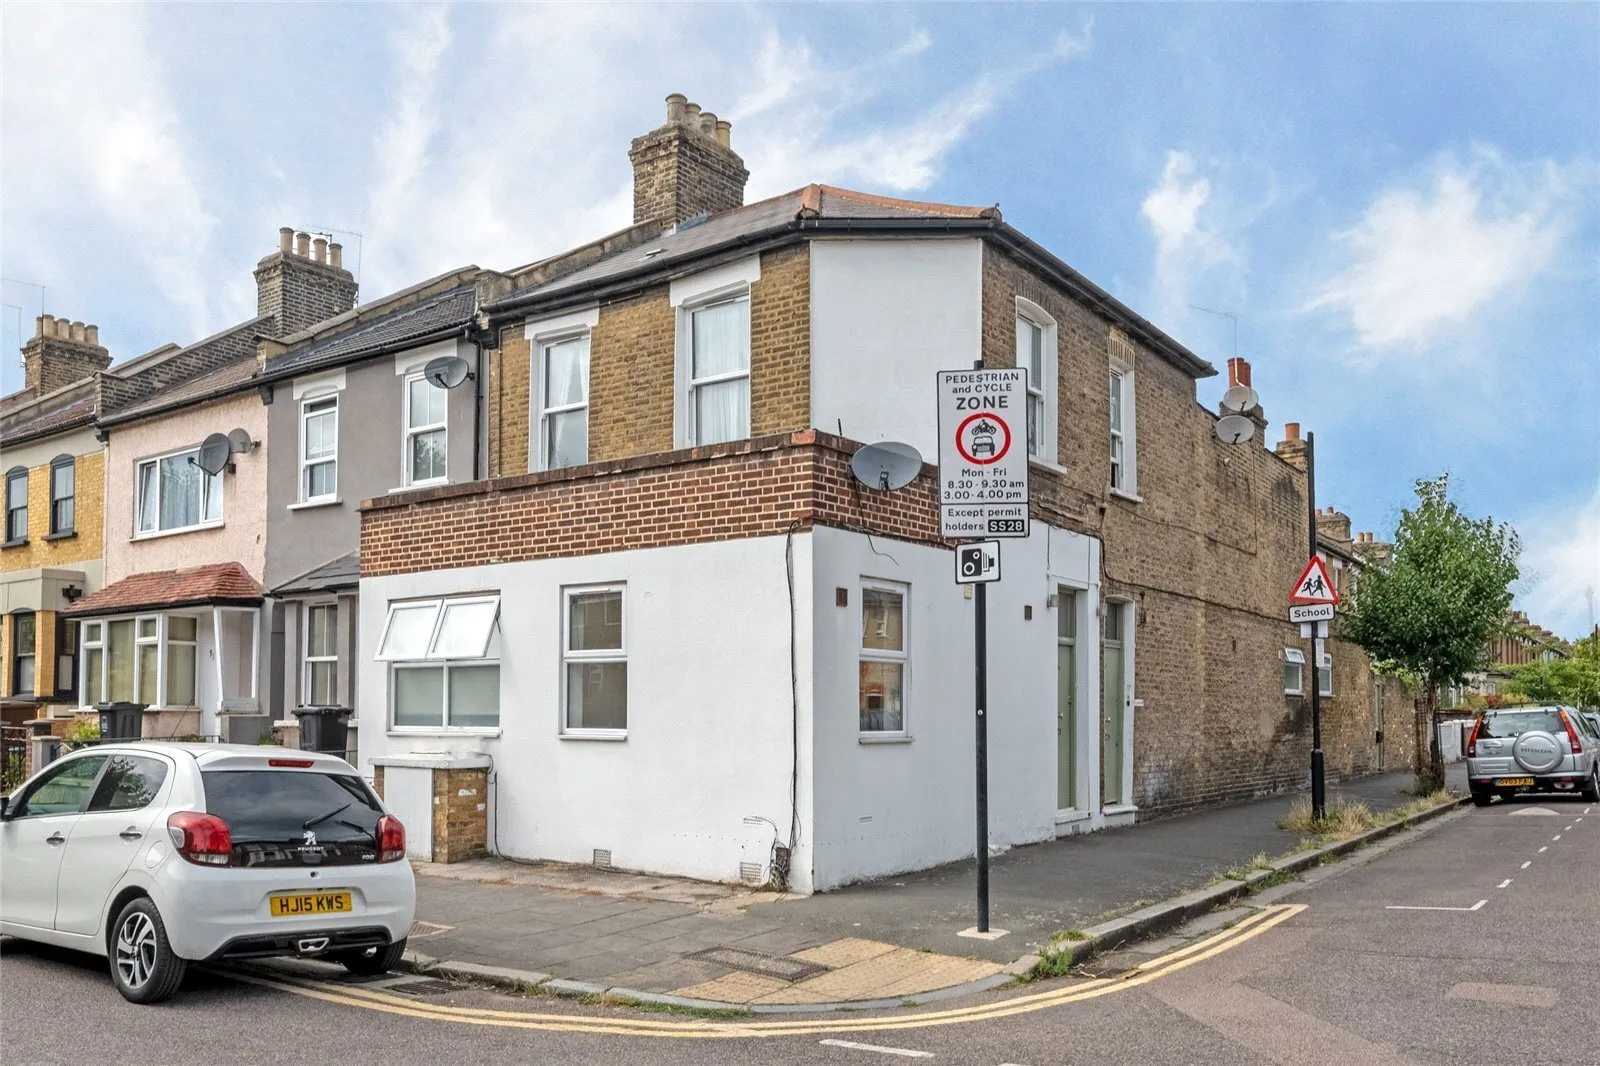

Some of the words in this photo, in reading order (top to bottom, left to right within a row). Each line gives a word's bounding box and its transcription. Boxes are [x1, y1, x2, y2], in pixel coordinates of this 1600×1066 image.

[945, 372, 1019, 384] PEDESTRIAN
[952, 385, 971, 394] and
[975, 383, 1012, 393] CYCLE
[956, 395, 1009, 410] ZONE
[961, 468, 984, 477] Mon
[993, 467, 1007, 476] Fri
[947, 480, 973, 489] 8.30
[981, 479, 1007, 488] 9.30
[1009, 480, 1025, 488] am
[944, 490, 970, 500] 3.00
[976, 489, 1004, 499] 4.00
[1006, 491, 1022, 499] pm
[948, 508, 984, 518] Except
[988, 507, 1022, 517] permit
[945, 522, 984, 531] holders
[989, 520, 1023, 532] SS28
[1294, 607, 1330, 618] School
[280, 897, 313, 913] HJ15
[316, 895, 344, 911] KWS
